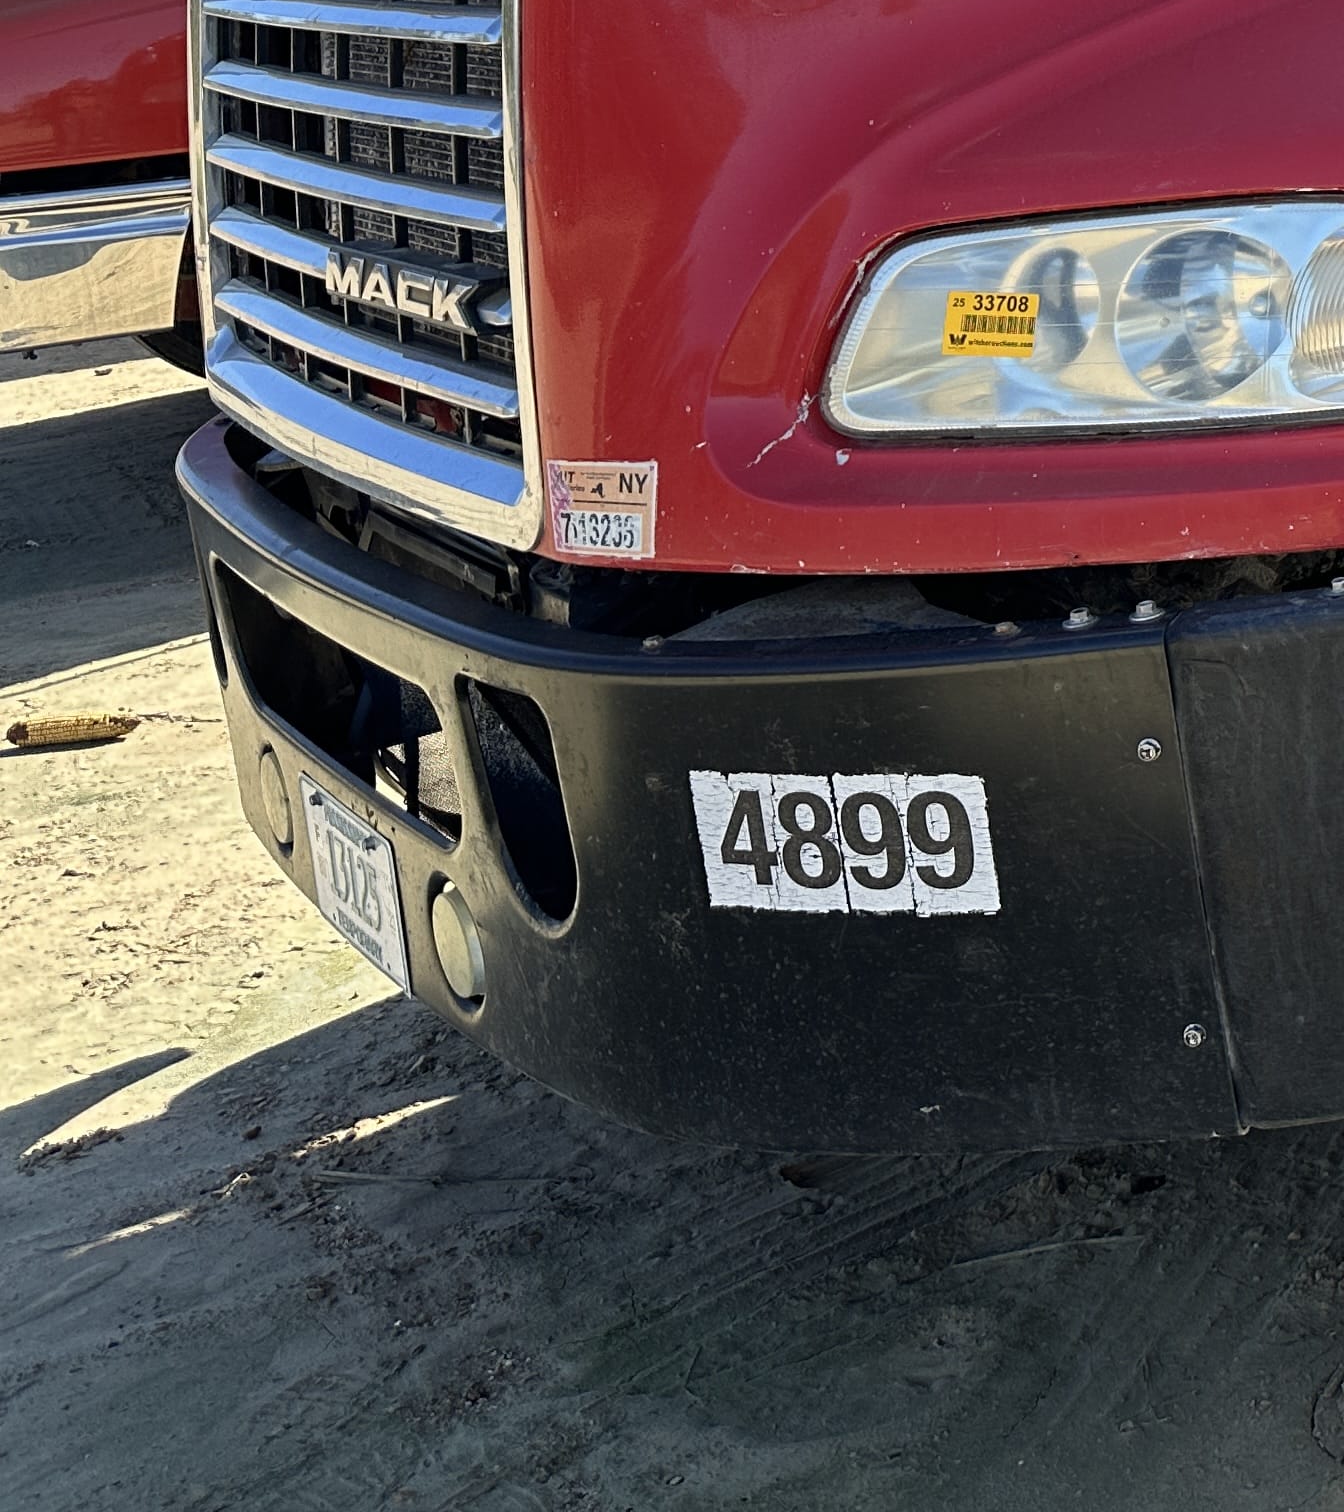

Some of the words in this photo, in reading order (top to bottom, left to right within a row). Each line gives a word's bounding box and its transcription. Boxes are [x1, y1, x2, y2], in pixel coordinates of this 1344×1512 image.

[325, 249, 480, 329] MACK
[952, 297, 966, 308] 25
[972, 294, 1030, 313] 33708
[618, 472, 649, 495] NY
[720, 788, 976, 891] 4899
